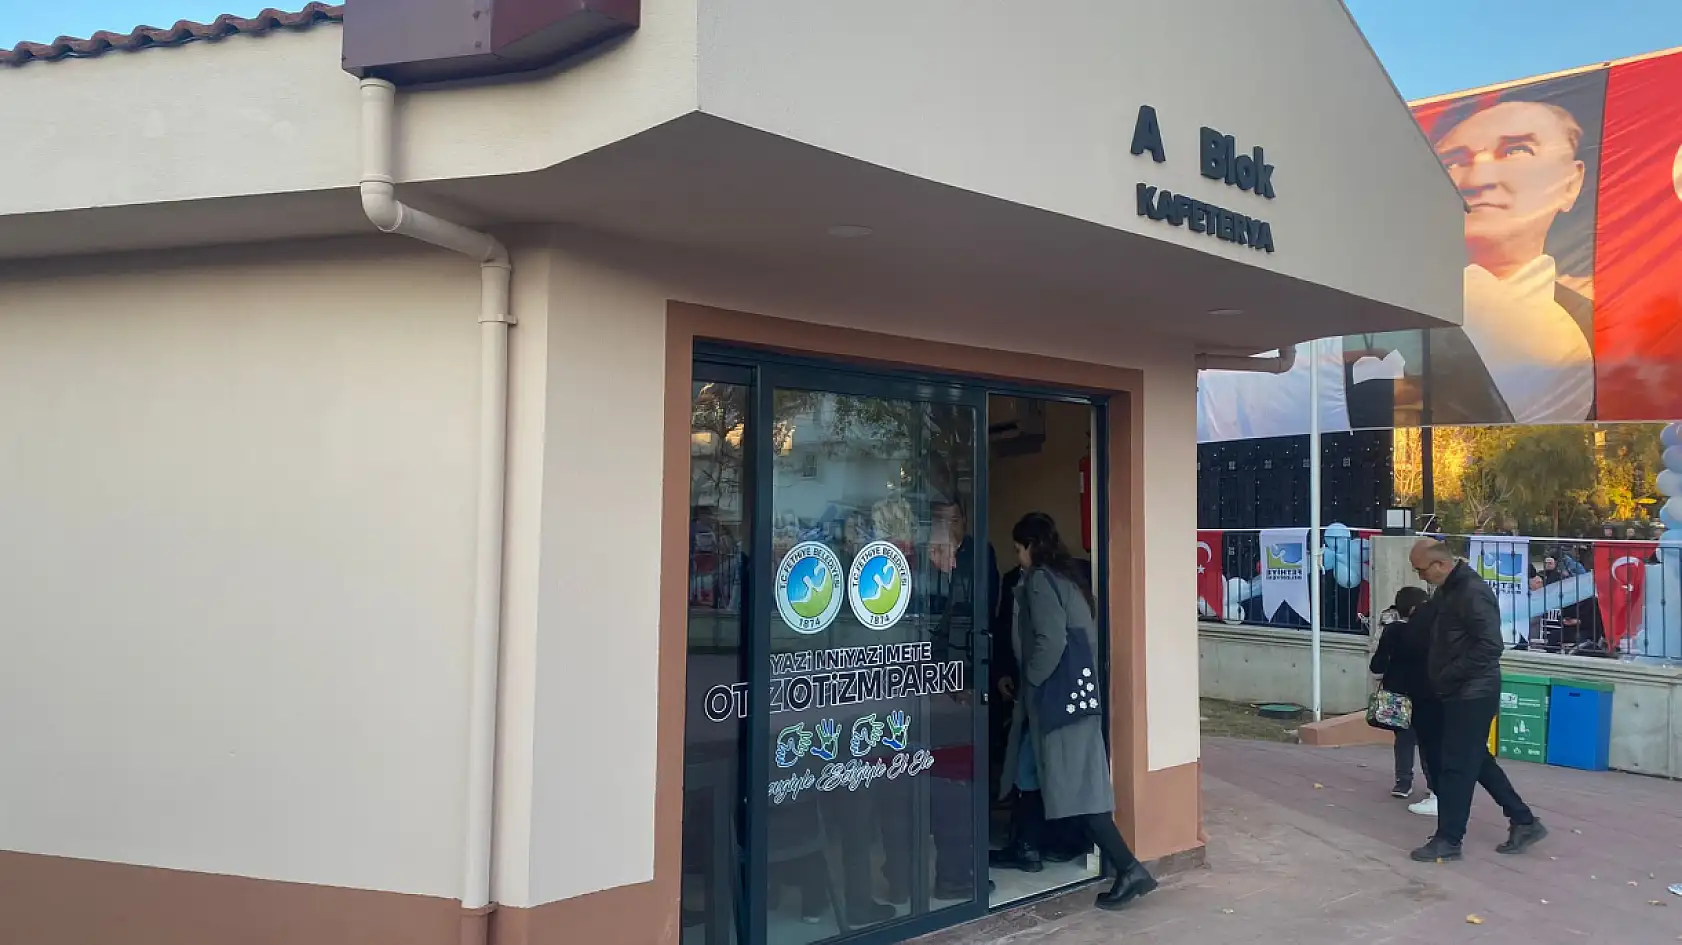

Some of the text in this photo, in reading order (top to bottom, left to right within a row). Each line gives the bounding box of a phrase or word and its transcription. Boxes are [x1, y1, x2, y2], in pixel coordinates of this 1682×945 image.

[1130, 105, 1276, 199] A Blok
[1136, 182, 1275, 253] KAFETERYA
[799, 618, 821, 629] 1874
[886, 641, 932, 665] METE
[886, 660, 964, 699] PARKI
